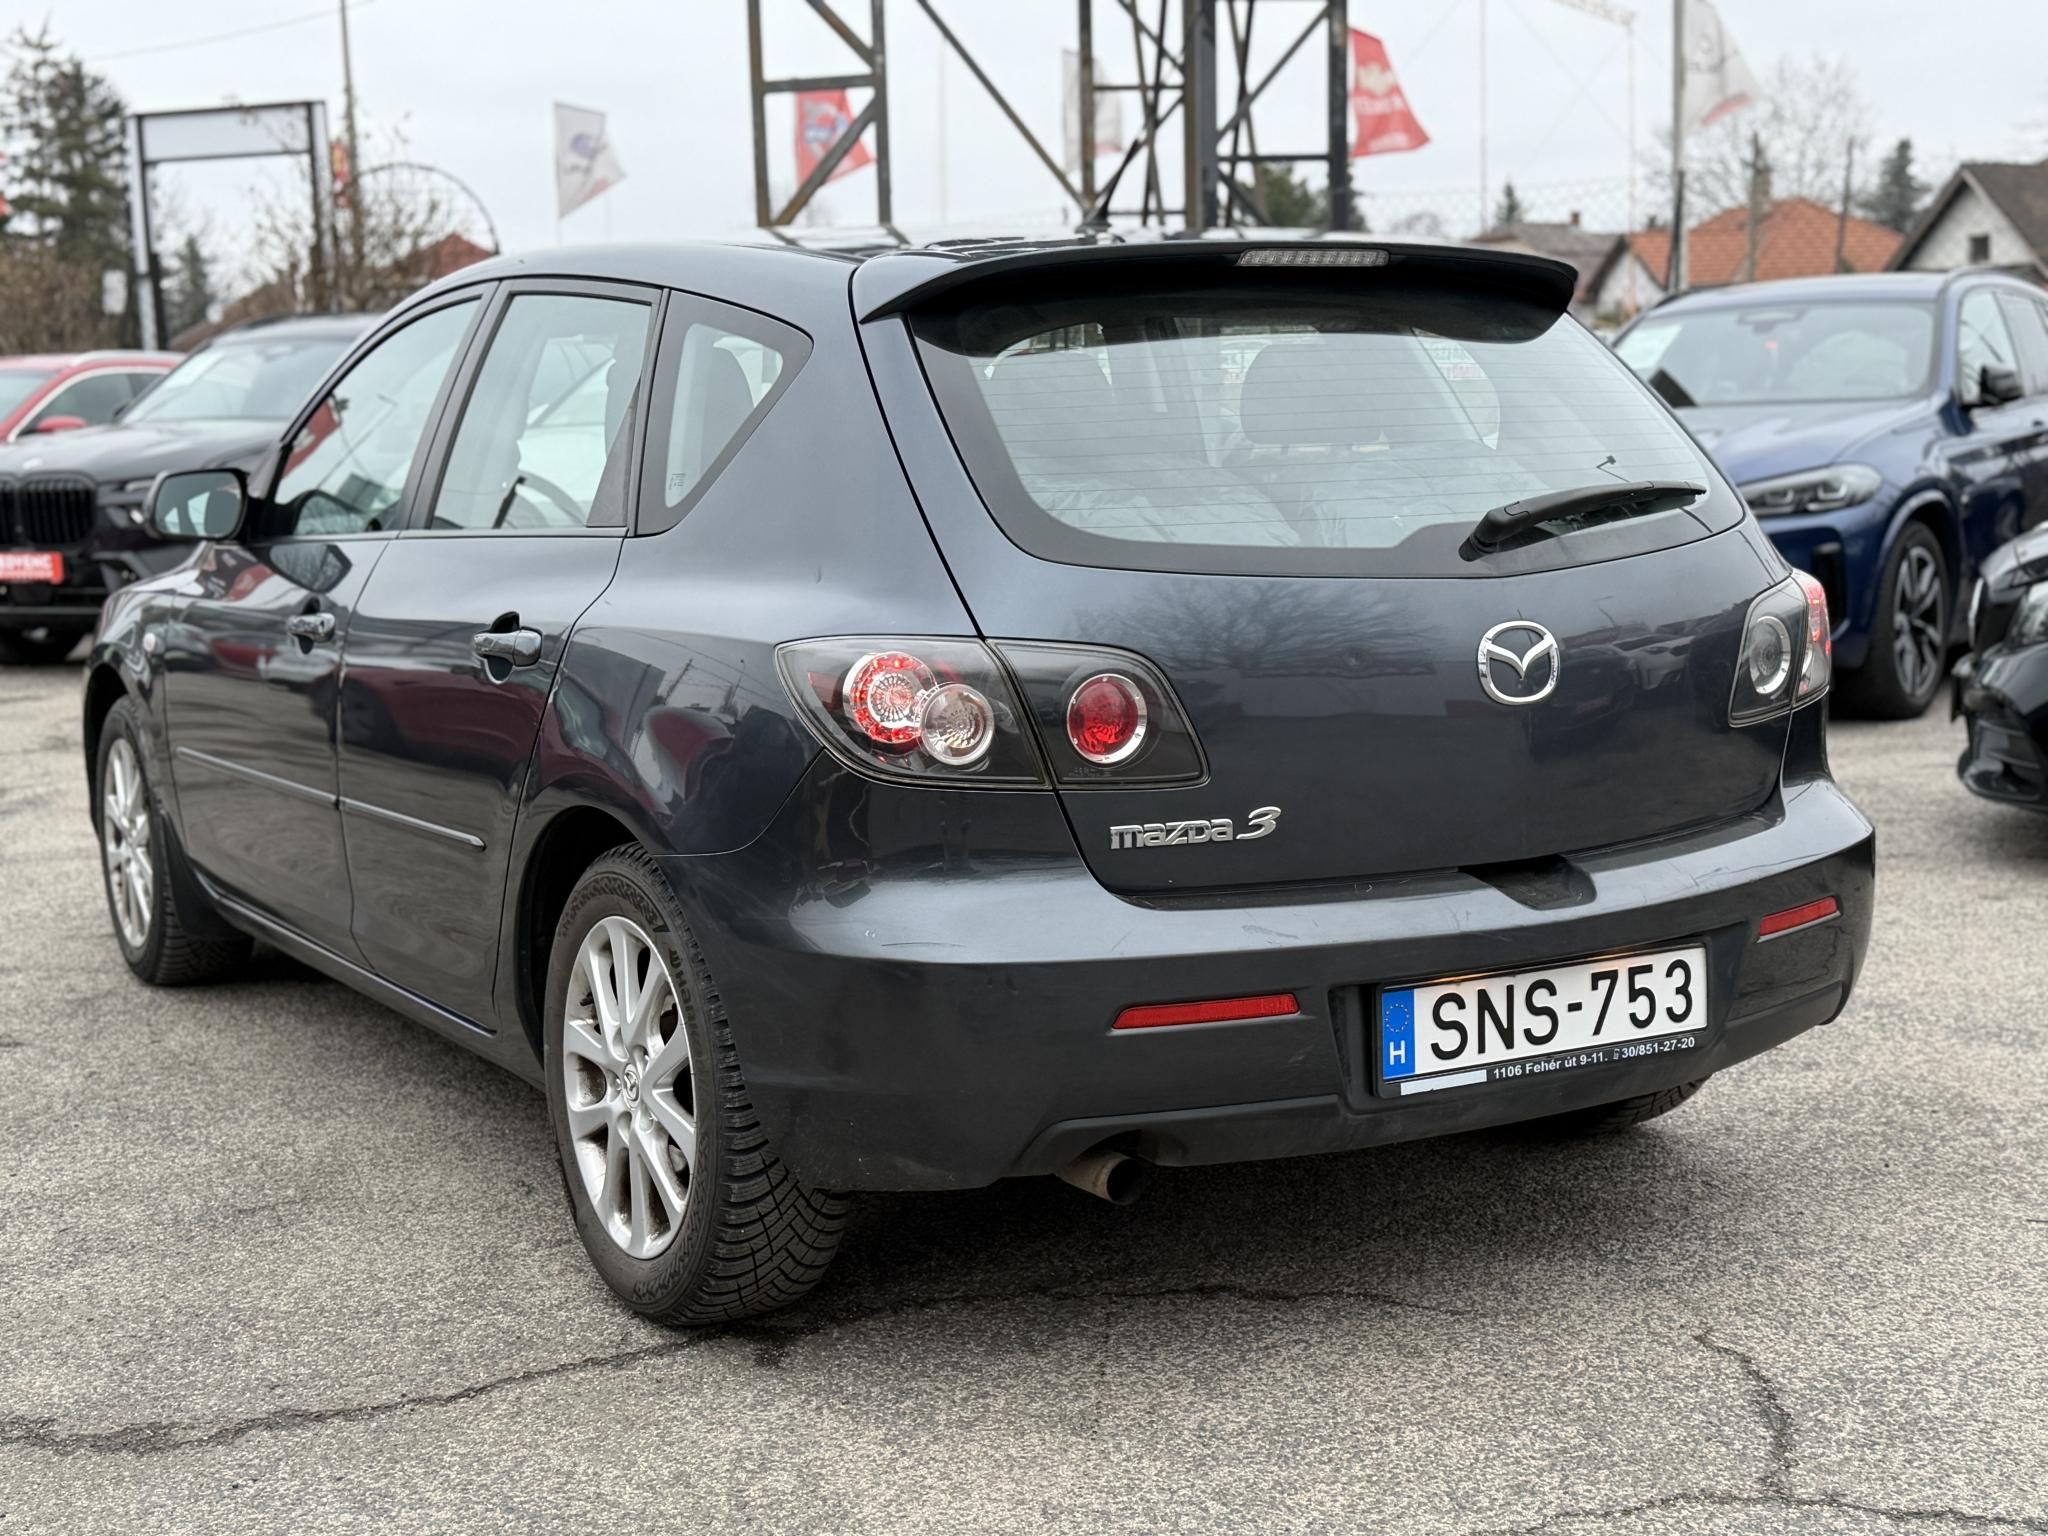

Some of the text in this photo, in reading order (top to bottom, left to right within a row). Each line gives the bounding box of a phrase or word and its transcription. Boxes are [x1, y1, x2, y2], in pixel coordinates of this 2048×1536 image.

[1236, 806, 1282, 839] 3
[1431, 959, 1693, 1060] SNS-753
[1389, 1038, 1406, 1066] H
[1493, 1036, 1696, 1079] 1106 Fehér út 9-11. 30/851-27-20
